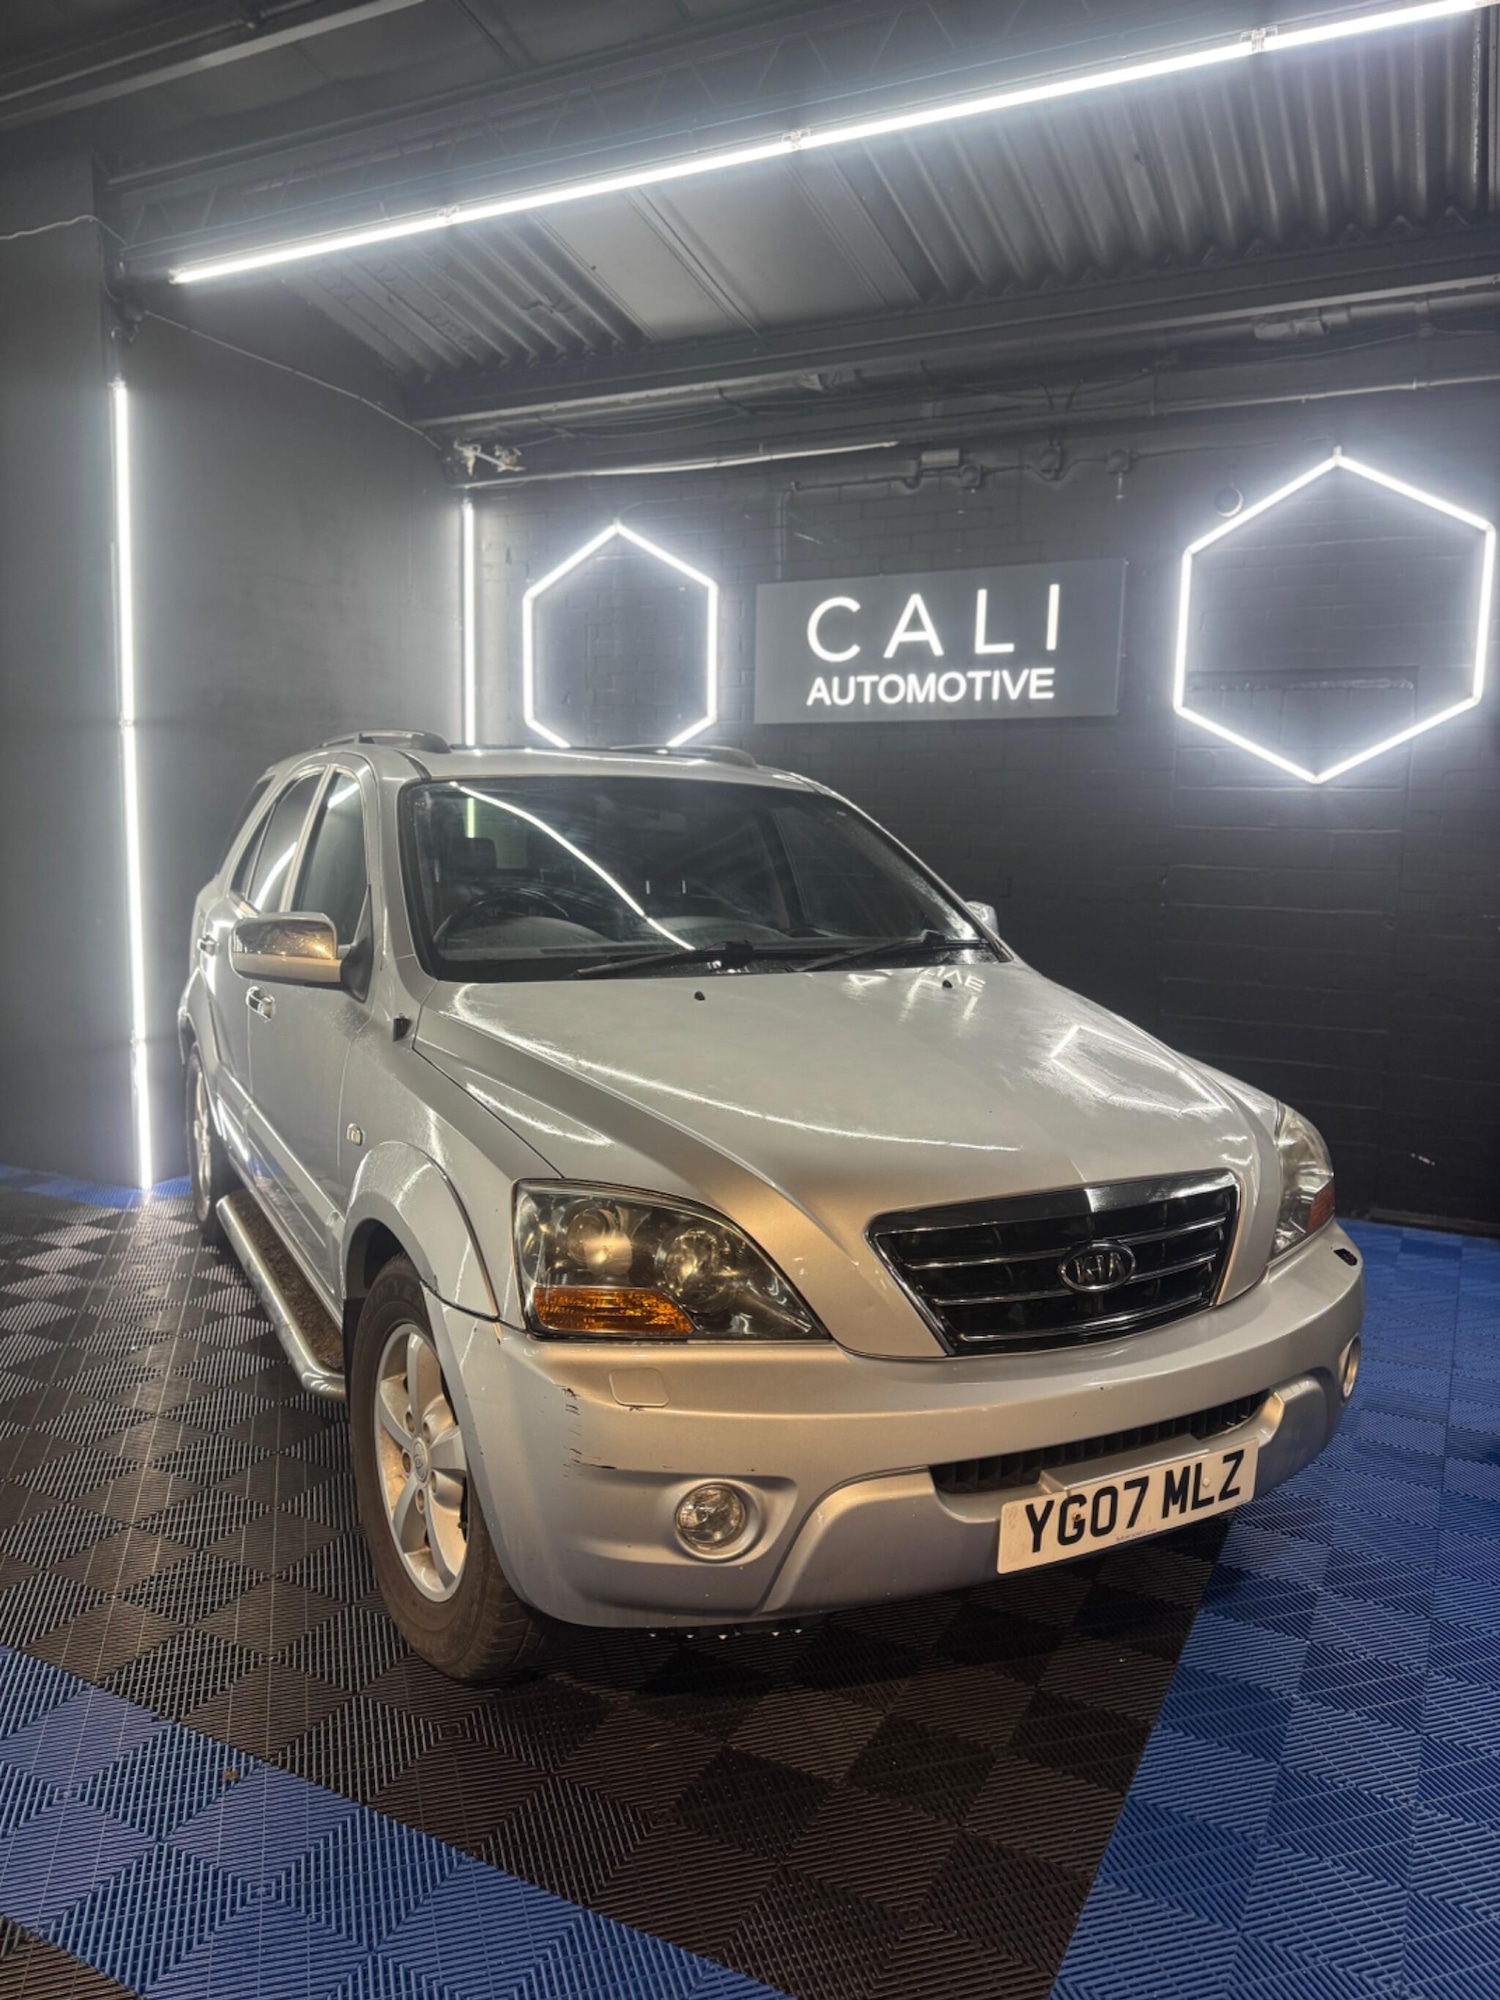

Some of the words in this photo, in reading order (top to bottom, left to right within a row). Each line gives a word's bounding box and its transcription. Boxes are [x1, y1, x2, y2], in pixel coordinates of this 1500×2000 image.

[807, 584, 1060, 662] CALI
[806, 668, 1055, 706] AUTOMOTIVE
[1074, 1252, 1126, 1282] KIA
[1025, 1476, 1149, 1553] YG07
[1161, 1449, 1245, 1519] MLZ
